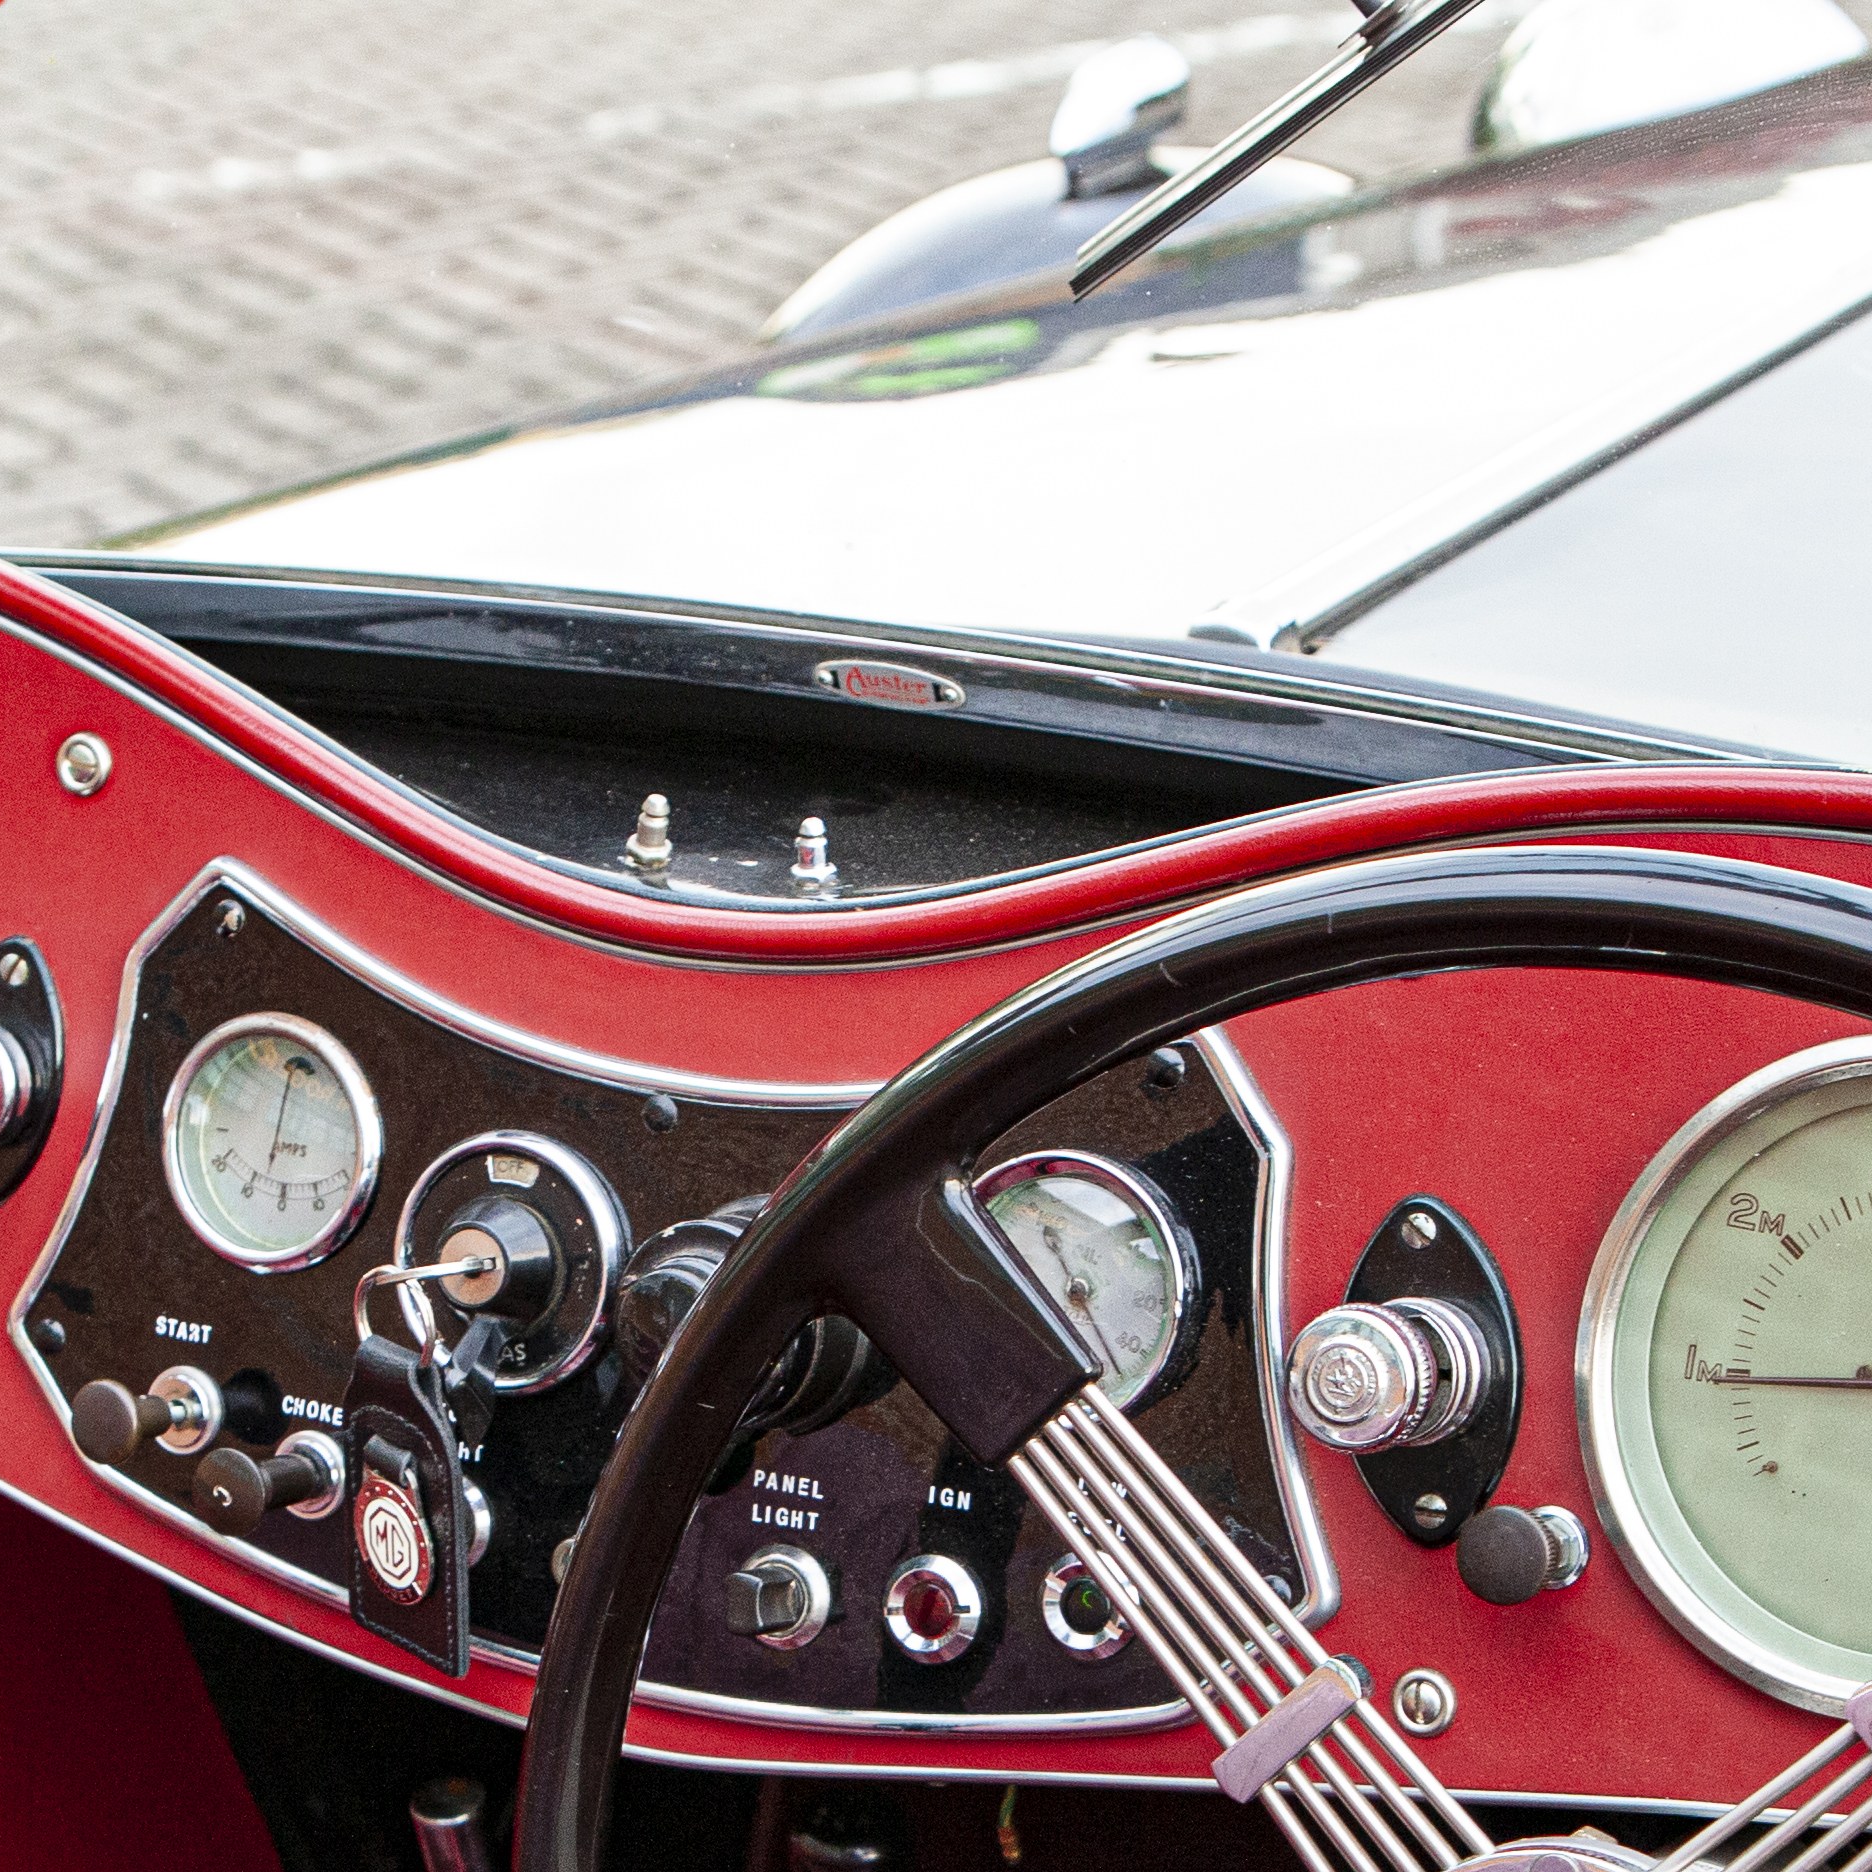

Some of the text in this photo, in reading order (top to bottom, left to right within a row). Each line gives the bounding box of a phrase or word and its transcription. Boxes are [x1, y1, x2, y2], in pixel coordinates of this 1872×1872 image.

[1727, 1192, 1785, 1237] 2M
[155, 1315, 213, 1344] START
[281, 1394, 344, 1427] CHOKE
[753, 1469, 825, 1500] PANEL
[928, 1485, 972, 1511] IGN
[751, 1503, 820, 1530] LIGHT
[375, 1519, 405, 1569] MG
